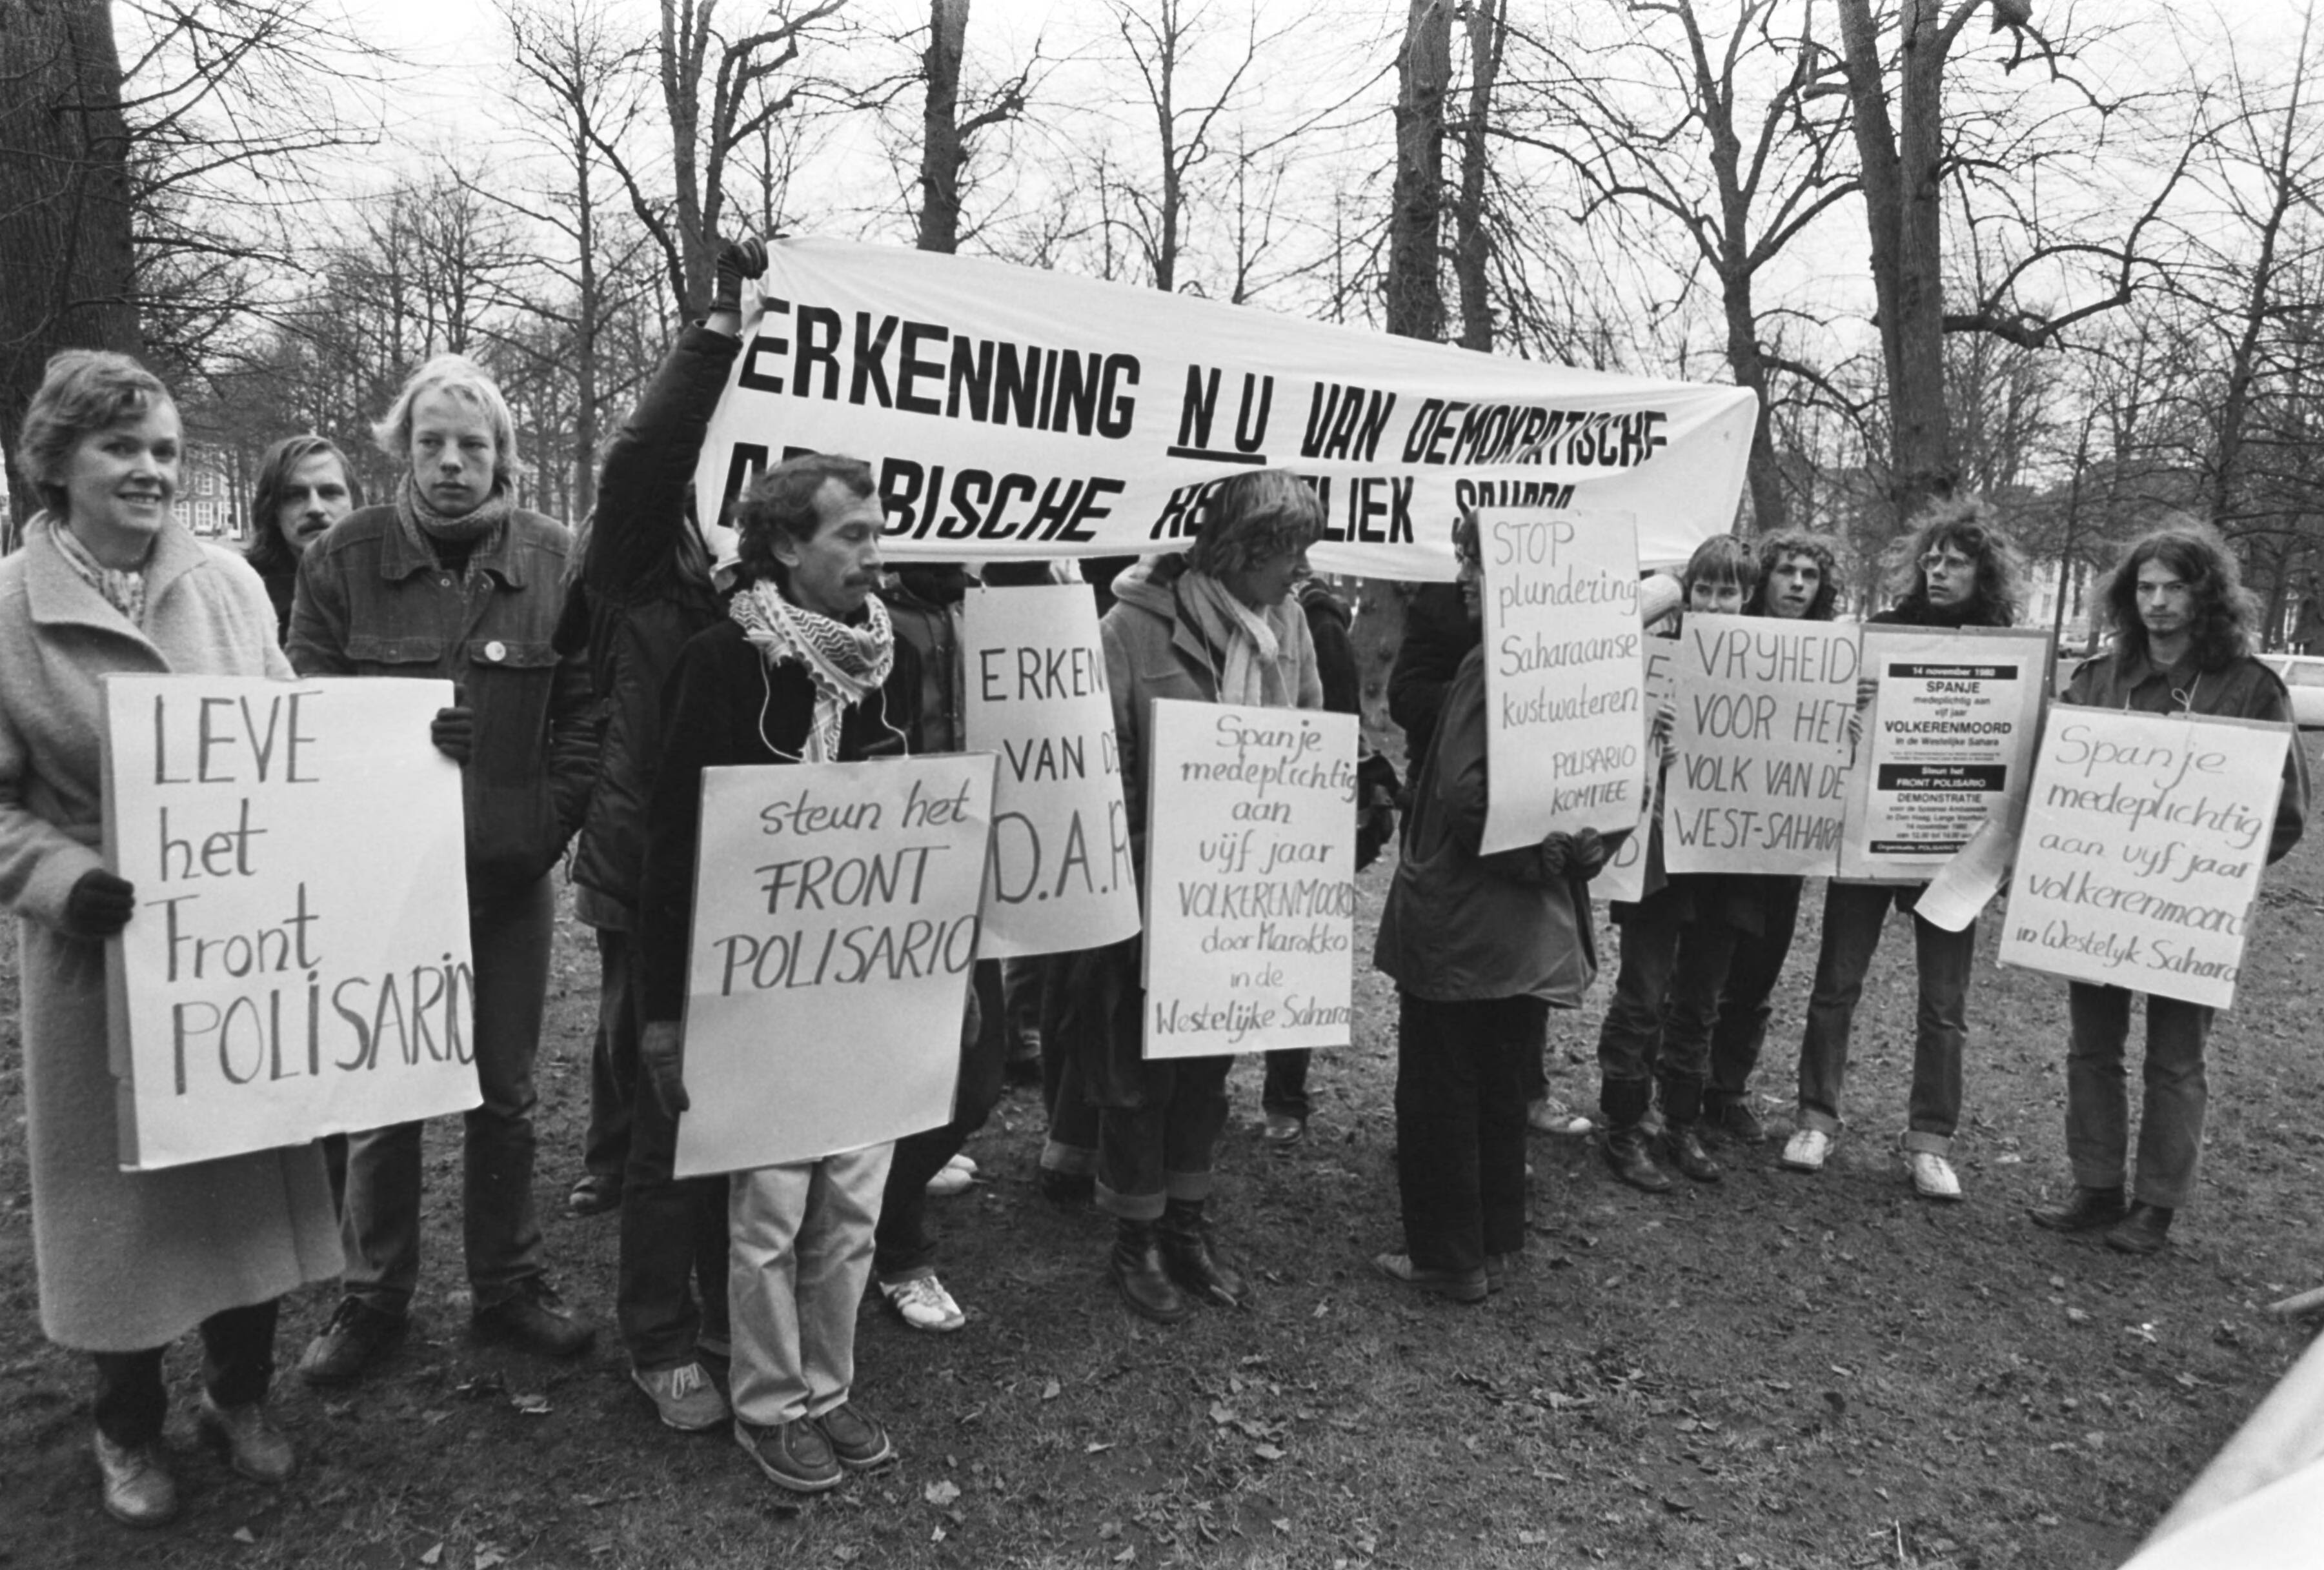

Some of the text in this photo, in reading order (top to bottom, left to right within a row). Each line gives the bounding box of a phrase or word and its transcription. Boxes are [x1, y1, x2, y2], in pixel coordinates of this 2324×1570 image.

[738, 296, 1140, 440] ERKENNING
[1301, 381, 1397, 462] VAN
[1401, 398, 1668, 467] DEMOKRATISCHE
[716, 441, 1126, 541] ABISCHE
[1150, 475, 1415, 543] RELIEK
[1493, 521, 1575, 567] STOP
[1500, 564, 1639, 627] plundering
[1500, 632, 1638, 676] Saharaanse
[1913, 666, 1923, 675] 14
[1925, 667, 1971, 677] november
[1926, 681, 1981, 694] SPANJE
[156, 691, 324, 784] LEVE
[1216, 715, 1322, 763] Spanje
[1694, 693, 1777, 741] VOOR
[1794, 699, 1857, 743] HET
[1885, 720, 2012, 734] VOLKERENMOORD
[1003, 736, 1086, 783] VAN
[1181, 754, 1357, 803] medeplichtig
[1553, 745, 1636, 780] POLISARIO
[1684, 752, 1851, 800] VOLK VAN DE
[2055, 725, 2227, 790] Spanje
[760, 778, 970, 835] steun het
[1551, 779, 1629, 816] KOMITEE
[1896, 778, 1931, 787] FRONT
[1897, 793, 1983, 803] DEMONSTRATIE
[1232, 800, 1292, 823] aan
[1674, 807, 1843, 851] WEST-SAHARA
[2046, 781, 2263, 850] medeplichtig
[161, 798, 267, 880] het
[1259, 839, 1334, 874] jaar
[2039, 833, 2105, 856] aan
[2172, 855, 2256, 883] jaar
[754, 845, 951, 914] FRONT
[713, 915, 978, 996] POLISARIO
[1202, 921, 1348, 954] door Marokko
[2016, 926, 2037, 942] in
[2147, 939, 2239, 985] Sahara
[1231, 961, 1284, 988] in de
[1157, 994, 1351, 1043] Westelijke Sahara
